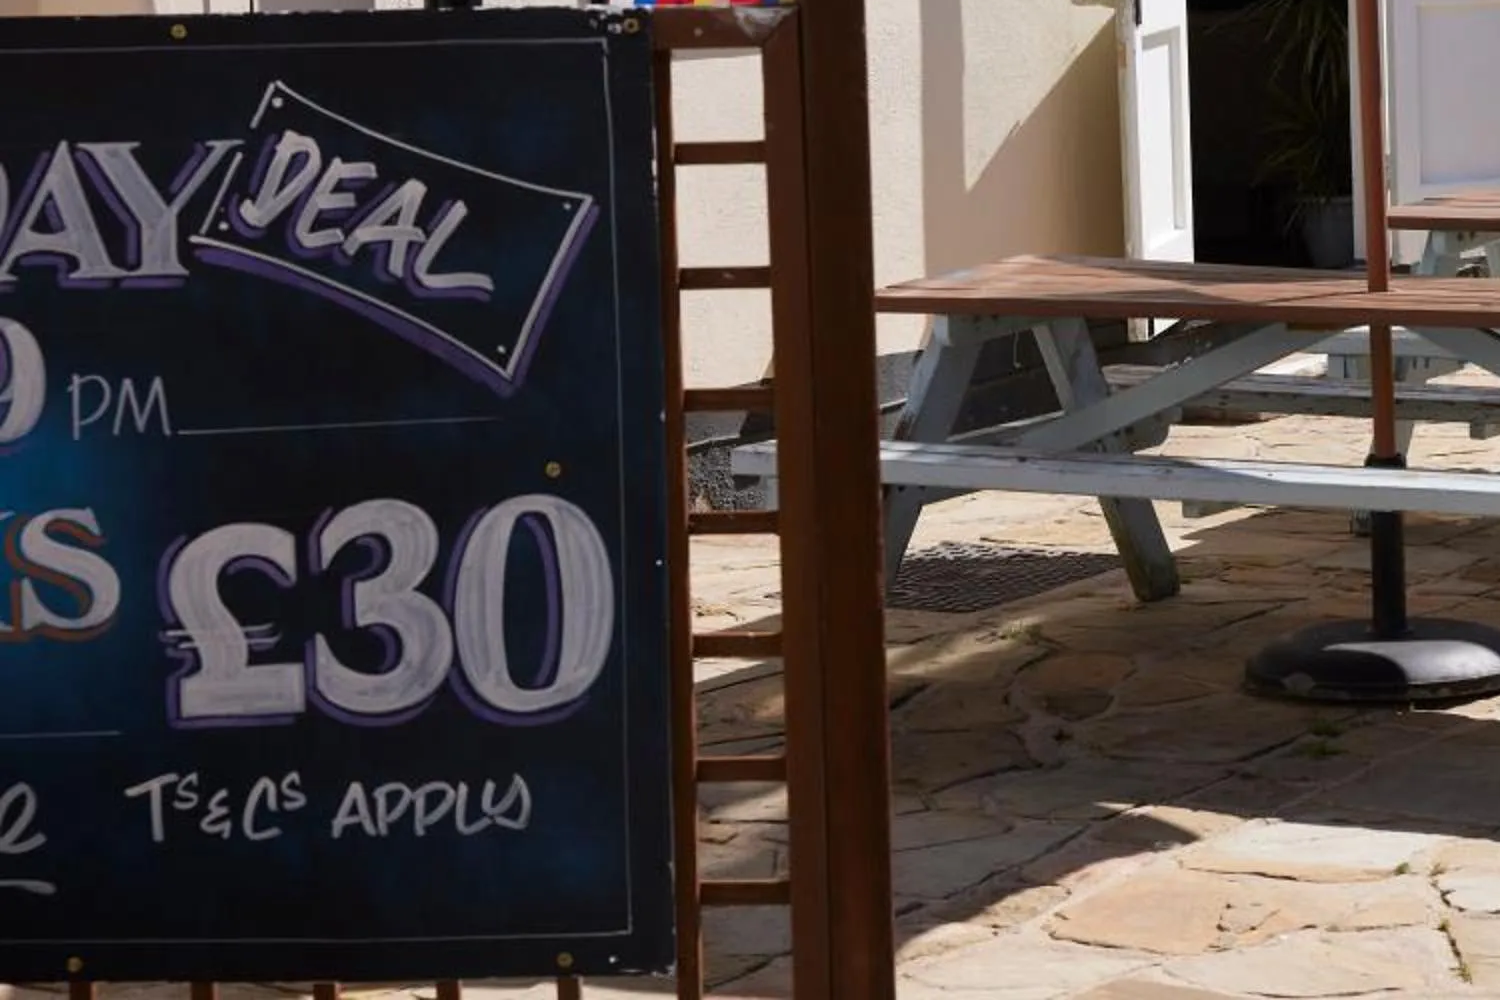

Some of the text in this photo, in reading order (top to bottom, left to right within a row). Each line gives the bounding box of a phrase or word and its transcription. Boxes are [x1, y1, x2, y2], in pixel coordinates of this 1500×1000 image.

[0, 129, 495, 292] AY DEAL
[163, 494, 614, 717] £30
[331, 772, 532, 839] APPLY
